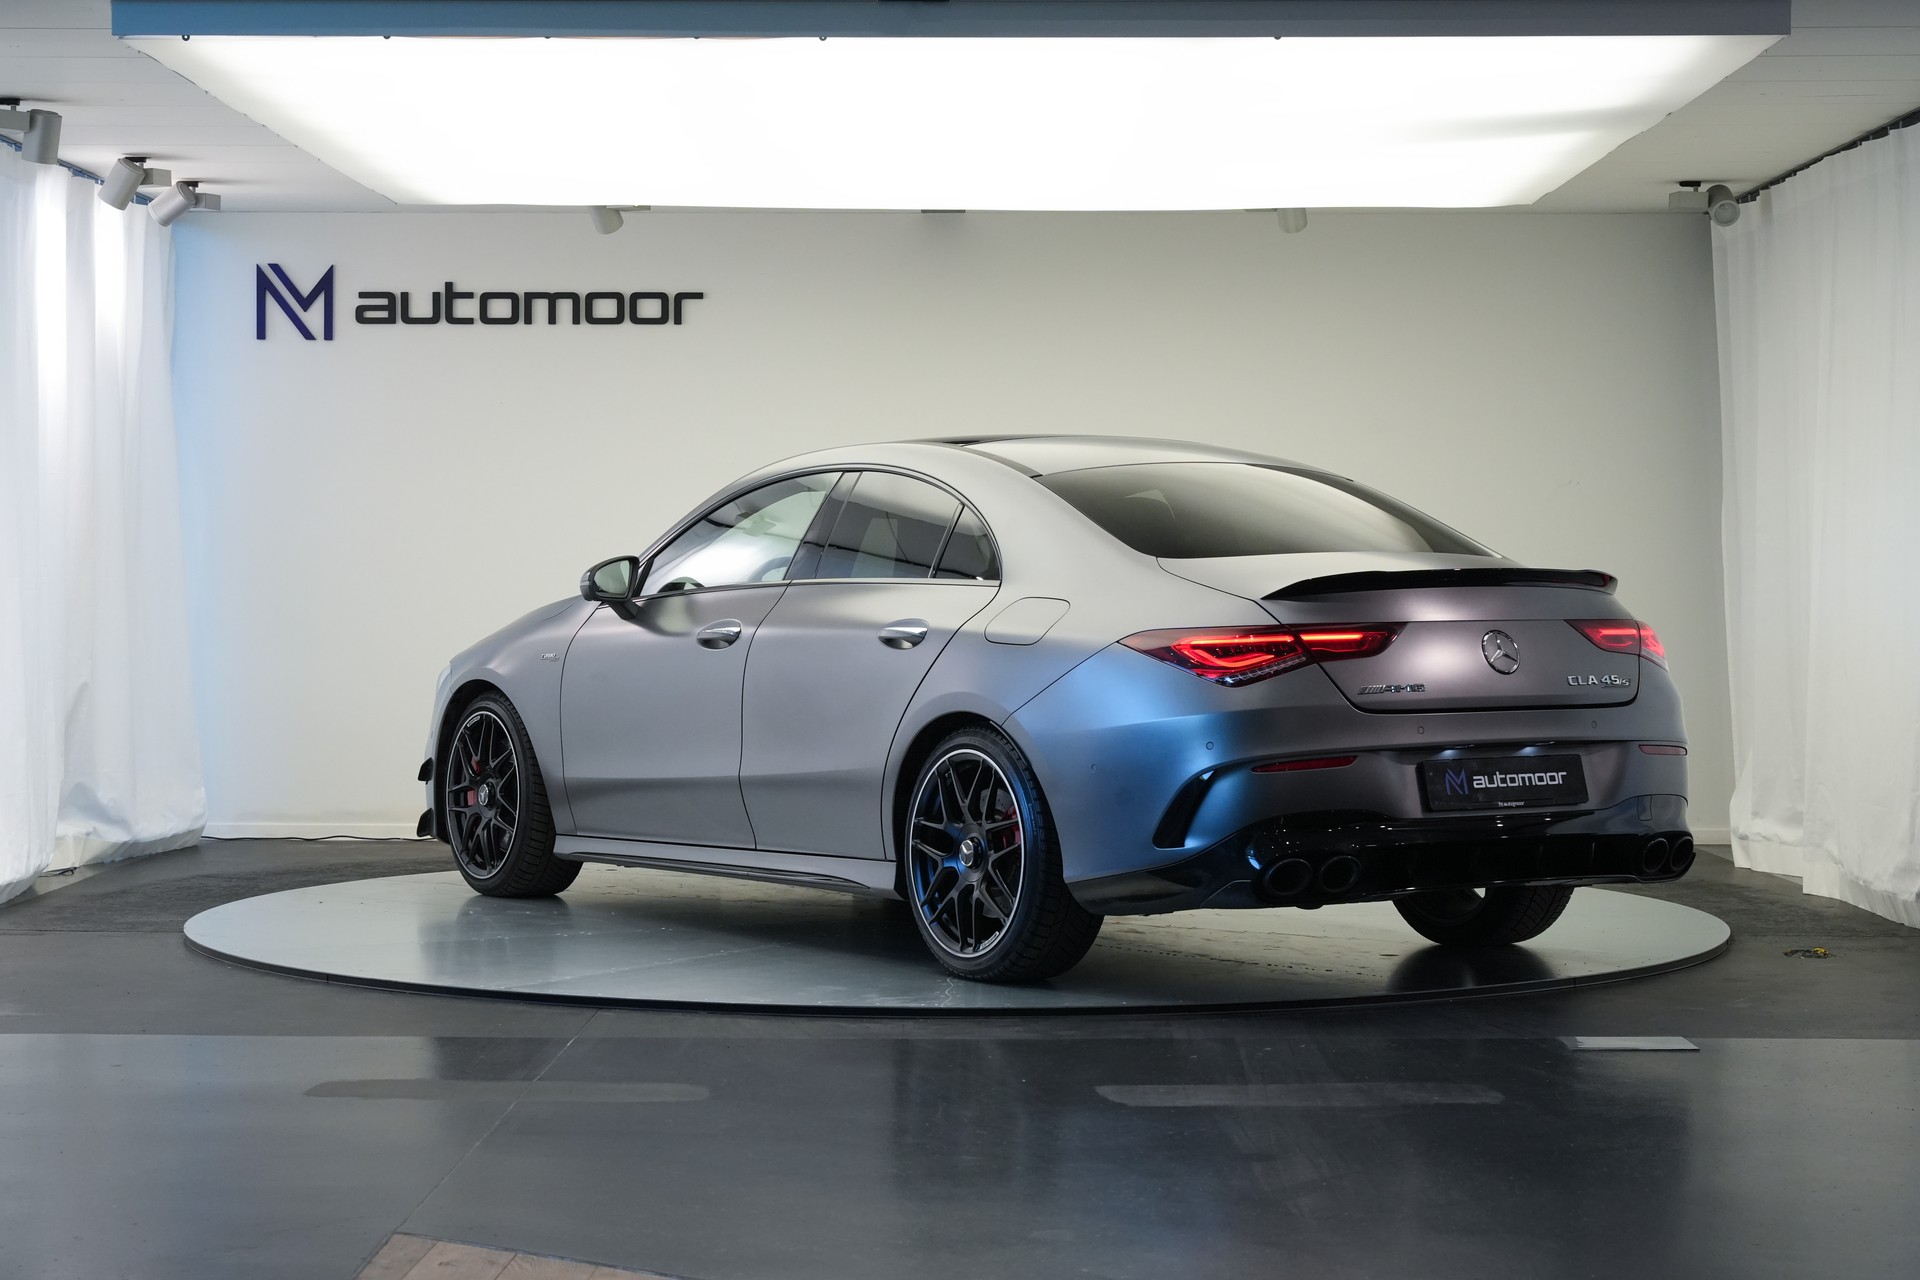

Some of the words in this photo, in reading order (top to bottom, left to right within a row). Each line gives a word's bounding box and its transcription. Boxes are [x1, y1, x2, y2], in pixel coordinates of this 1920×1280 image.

[355, 281, 704, 325] automoor
[1567, 674, 1598, 686] CLA
[1473, 771, 1567, 788] automoor
